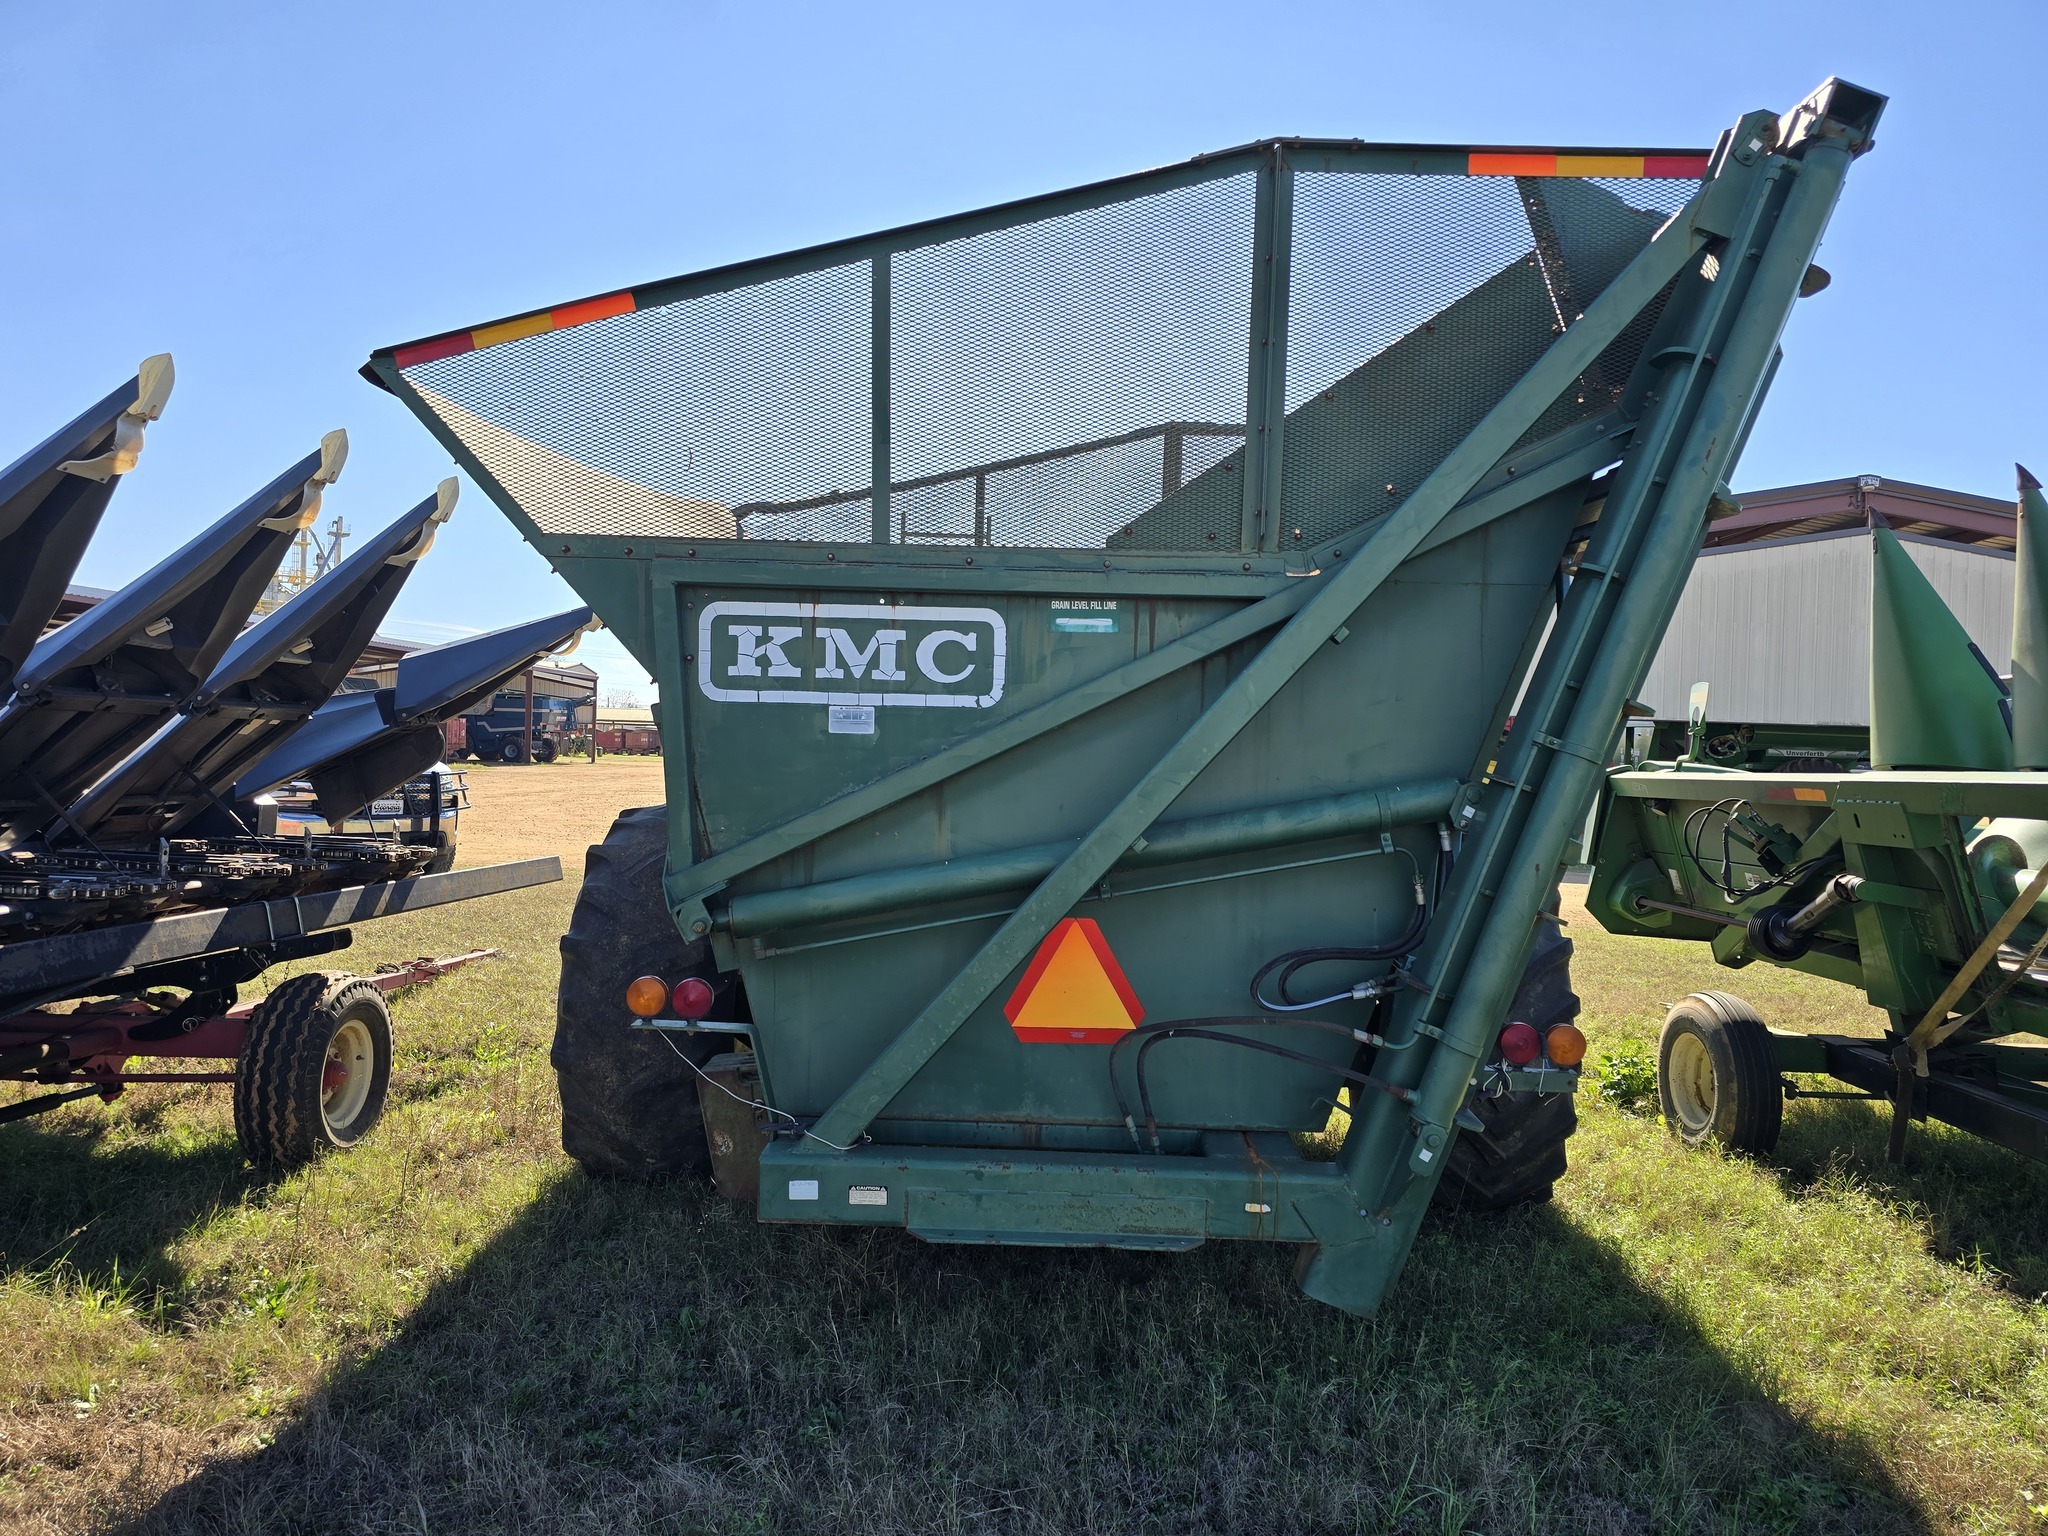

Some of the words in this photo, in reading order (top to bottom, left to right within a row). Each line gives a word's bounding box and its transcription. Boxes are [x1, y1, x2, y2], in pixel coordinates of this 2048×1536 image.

[1051, 600, 1070, 610] GRAIN
[1071, 601, 1089, 610] LEVEL
[1090, 601, 1102, 610] FILL
[1103, 601, 1117, 610] LINE
[728, 624, 978, 684] KMC
